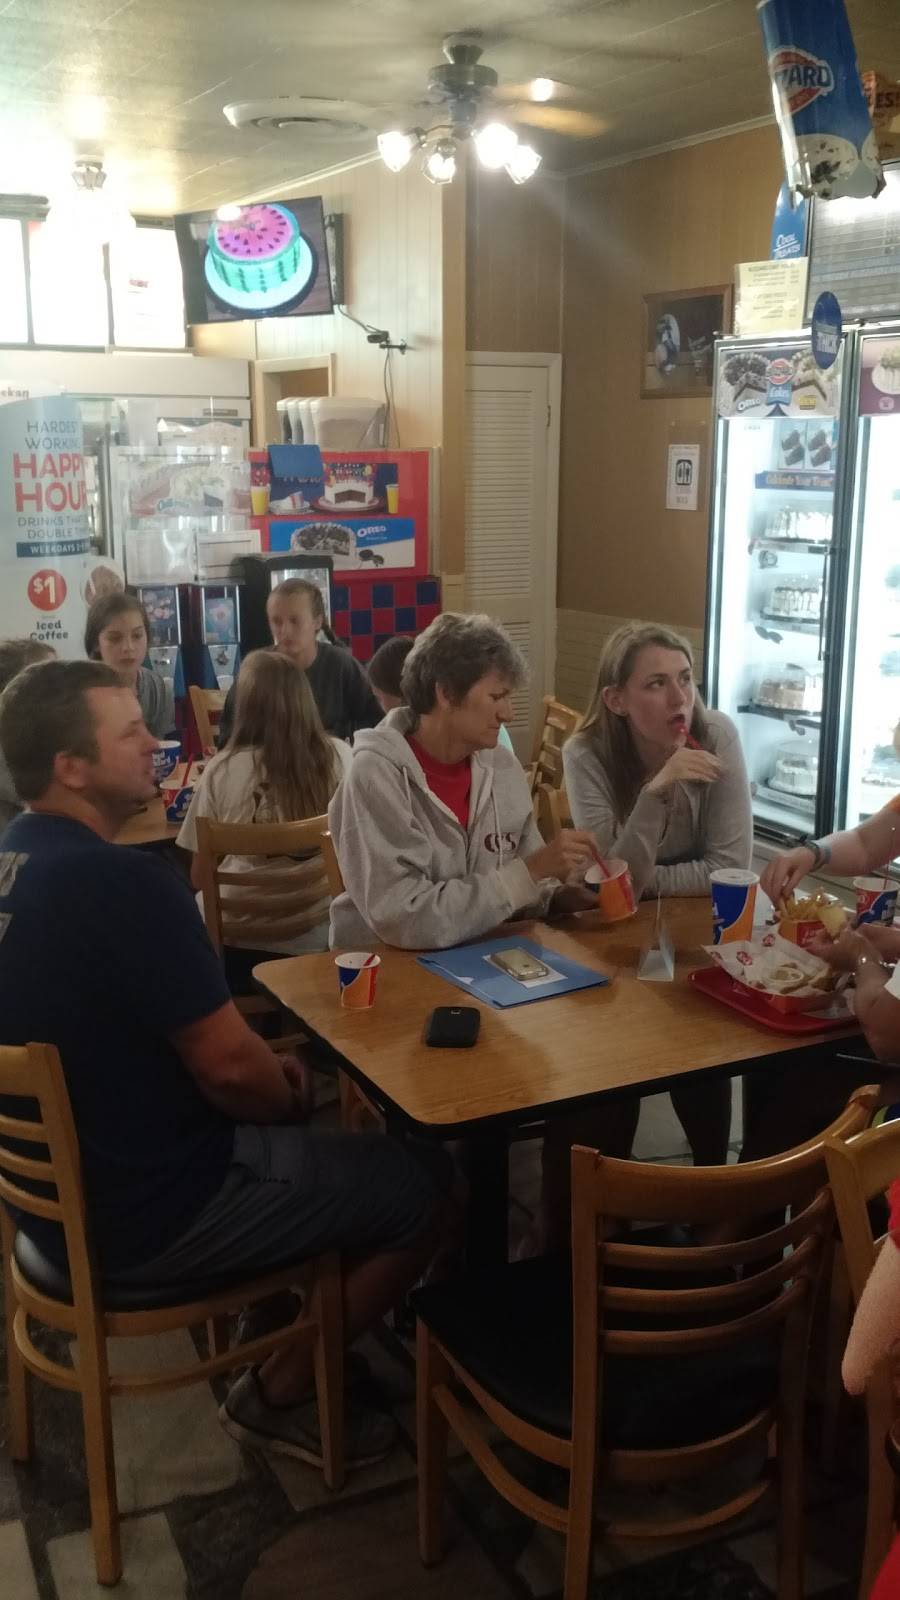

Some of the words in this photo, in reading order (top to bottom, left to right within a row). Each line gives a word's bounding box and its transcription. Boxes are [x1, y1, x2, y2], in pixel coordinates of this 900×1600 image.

[17, 516, 64, 527] DRINKS
[27, 529, 73, 539] DOUBLE
[356, 525, 386, 538] OREO
[30, 544, 75, 555] WEEKDAYS
[33, 575, 56, 604] $1
[36, 619, 62, 631] Iced
[30, 630, 69, 642] Coffee
